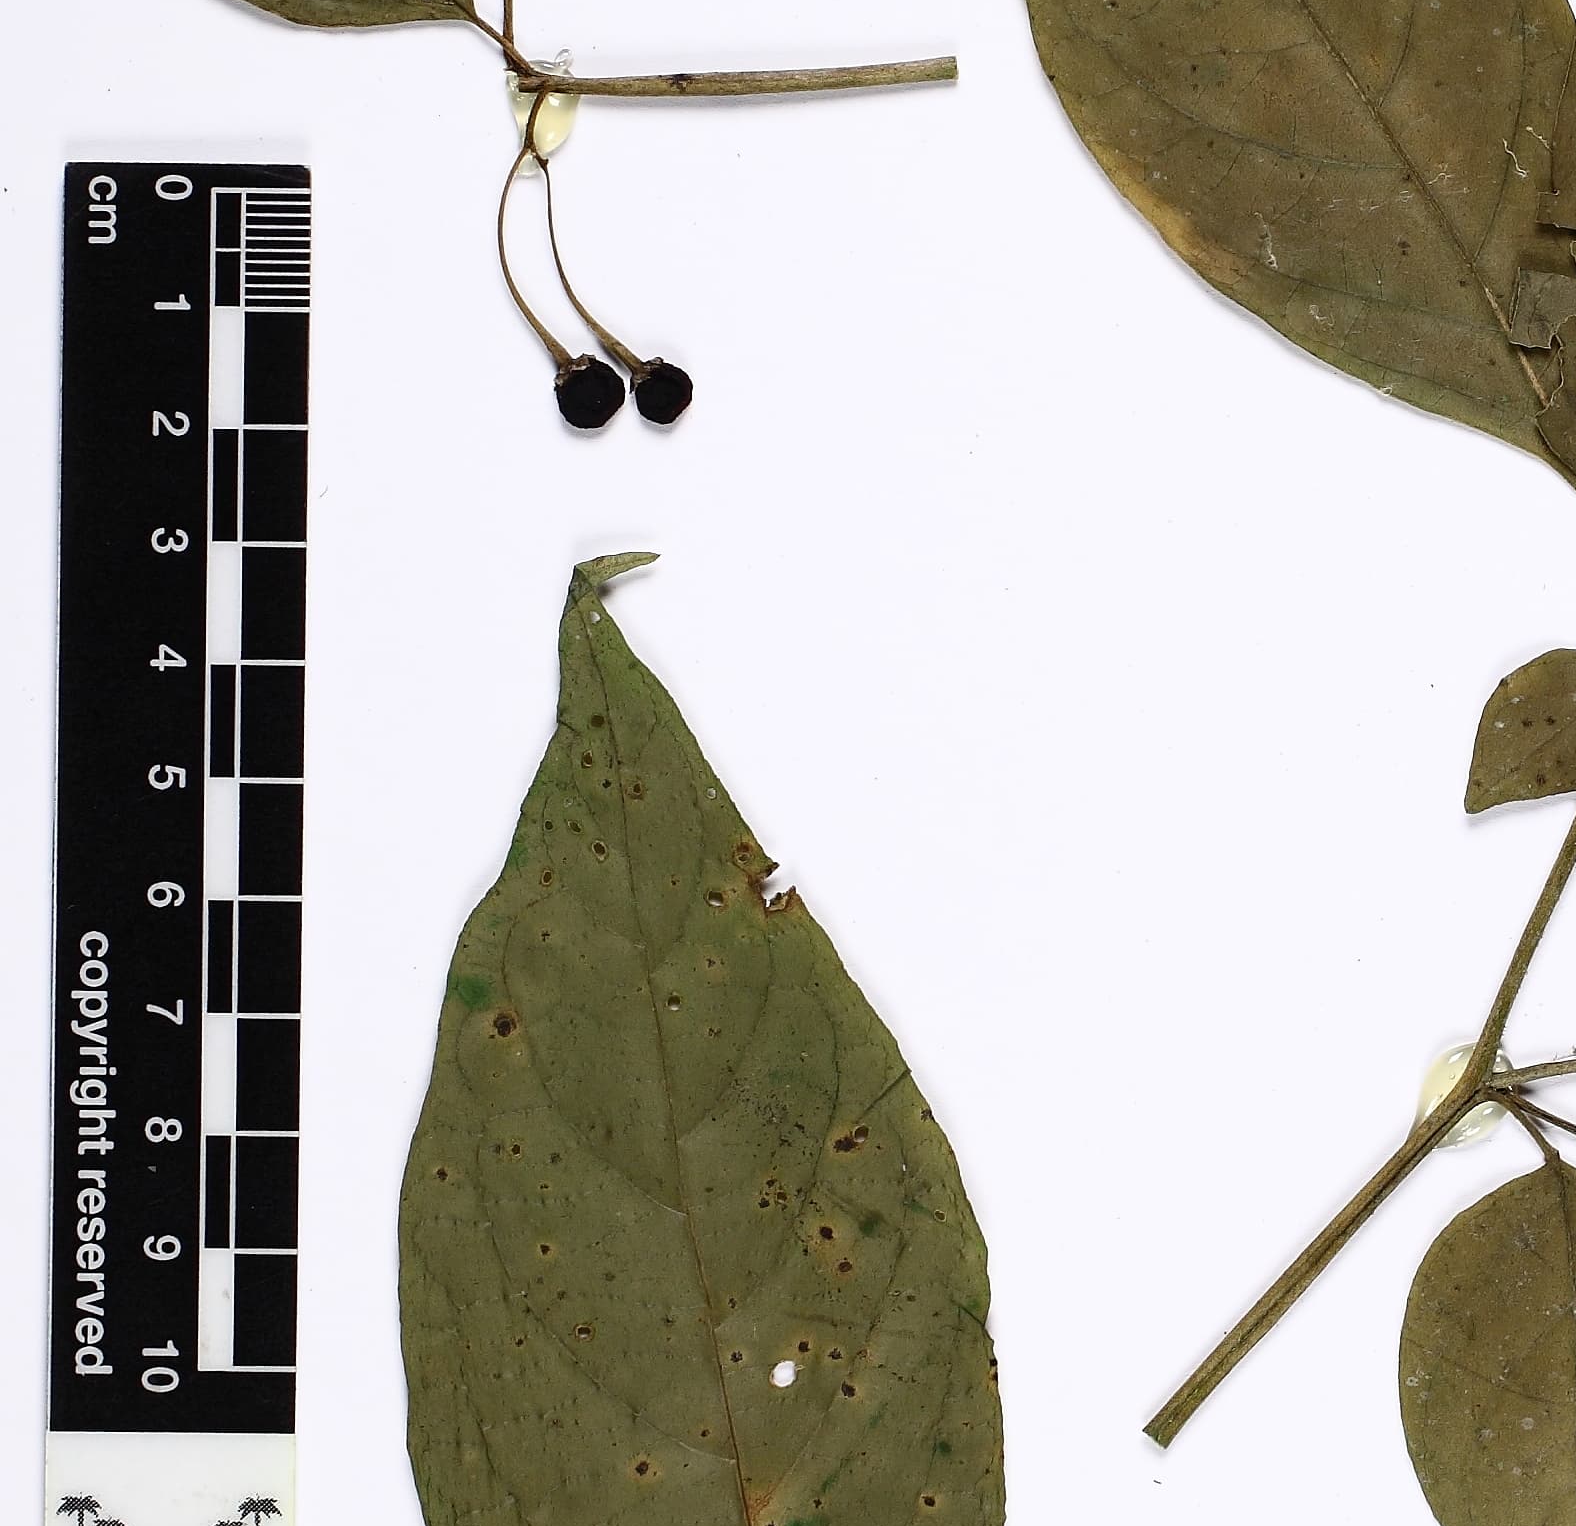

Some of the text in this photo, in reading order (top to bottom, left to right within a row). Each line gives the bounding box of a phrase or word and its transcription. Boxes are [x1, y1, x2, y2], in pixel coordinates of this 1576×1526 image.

[88, 176, 117, 243] cm
[142, 175, 192, 1392] 0 1 2 3 4 5 6 7 8 9 10
[70, 931, 116, 1375] copyright reserved
